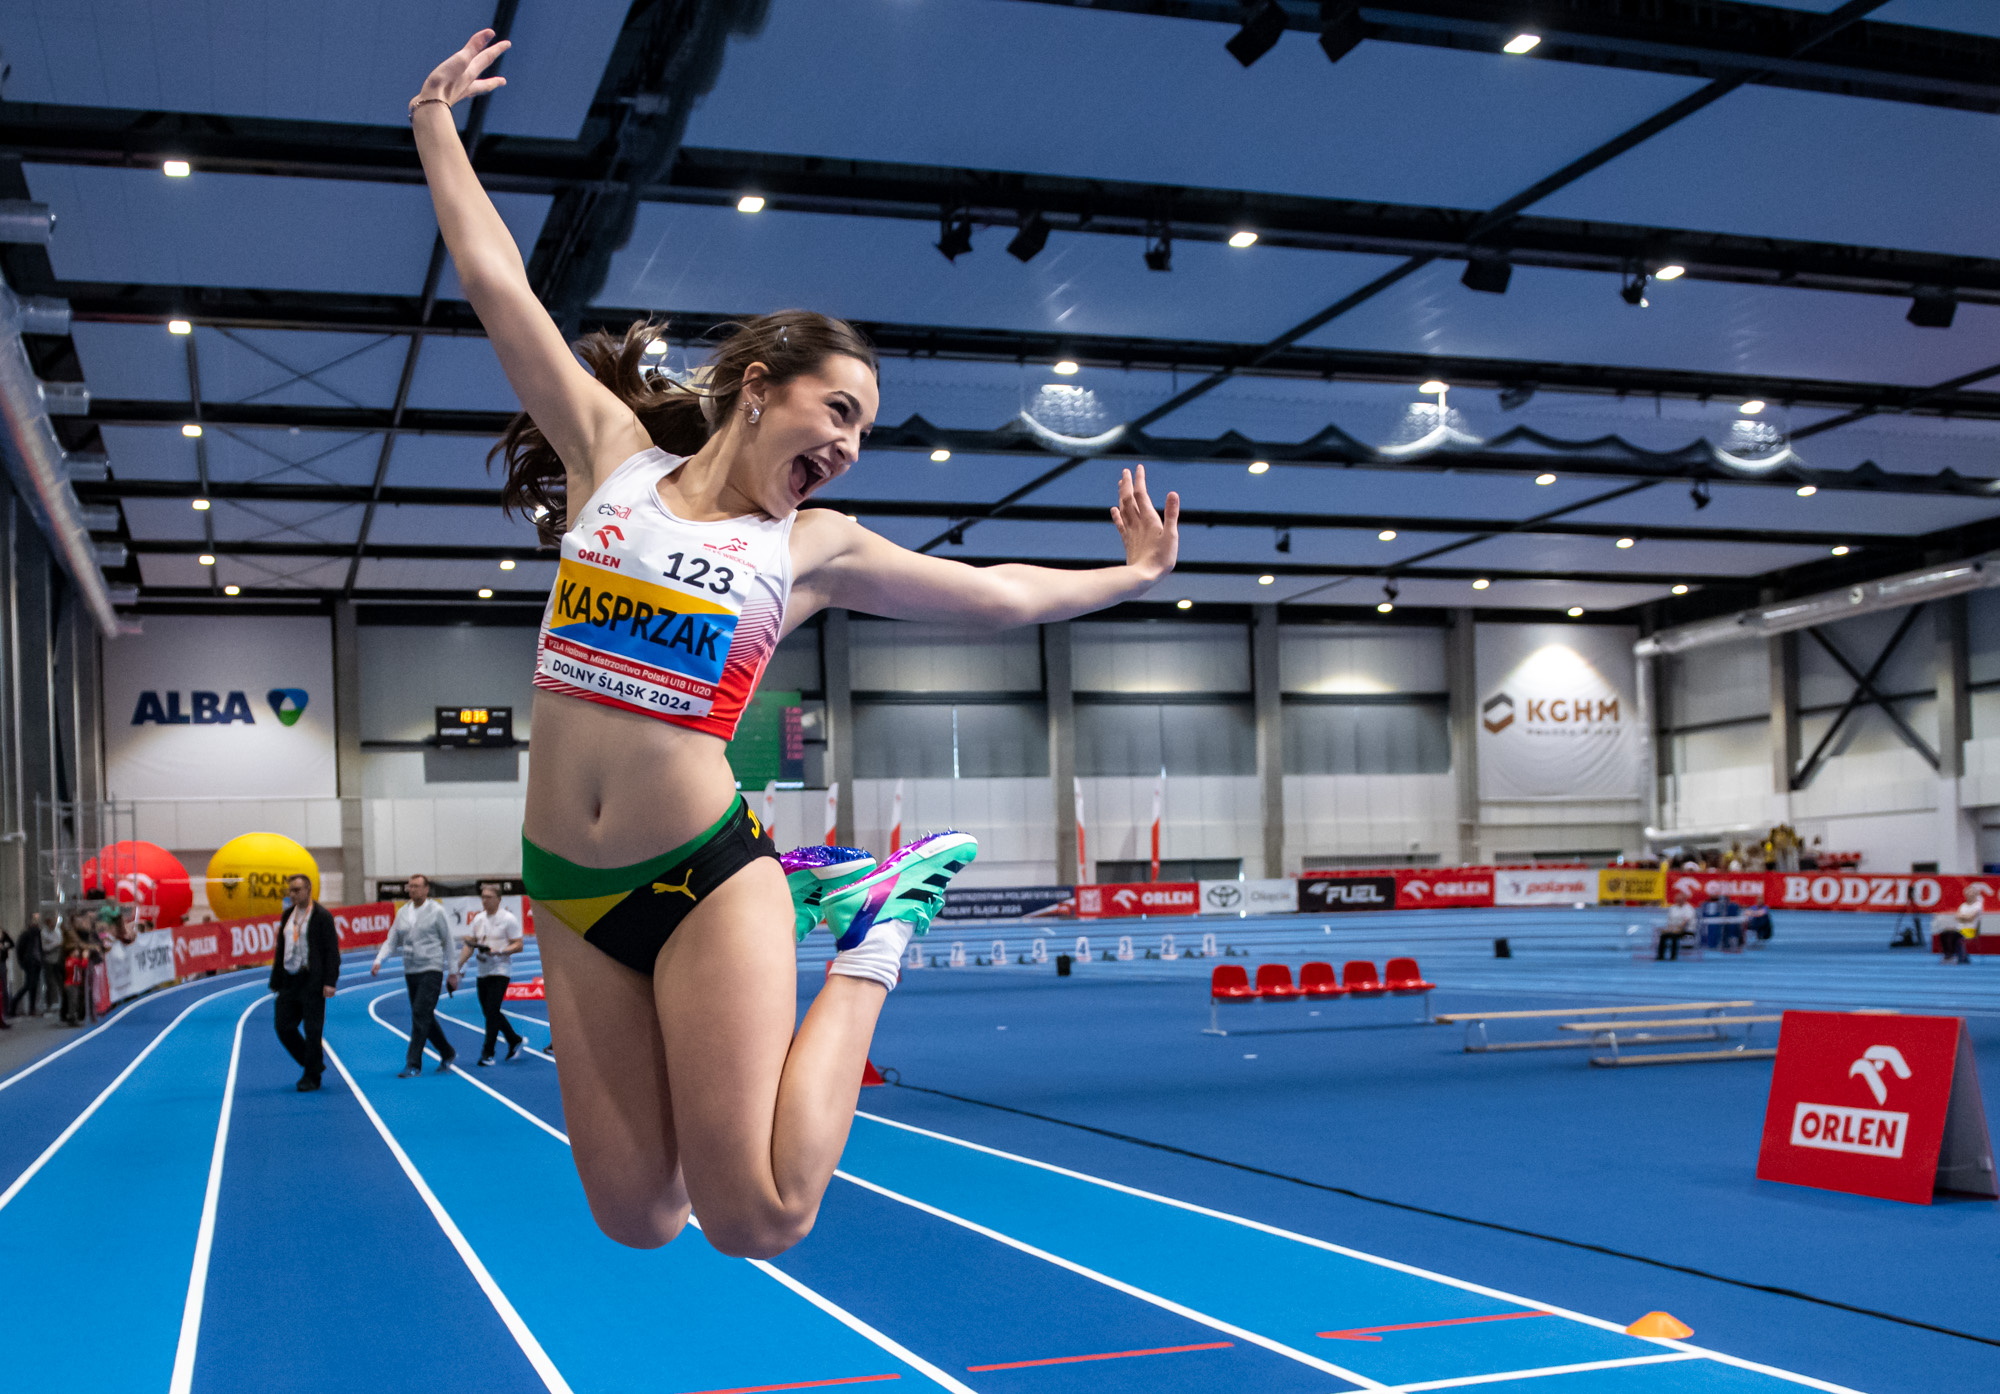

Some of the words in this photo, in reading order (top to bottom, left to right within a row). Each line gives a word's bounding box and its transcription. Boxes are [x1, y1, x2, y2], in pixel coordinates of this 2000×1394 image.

[577, 549, 621, 569] ORLEN
[662, 552, 734, 595] 123
[558, 579, 725, 662] KASPRZAK
[565, 644, 589, 660] Halowe
[590, 654, 641, 676] Mistrzostwa
[642, 669, 670, 685] Polski
[670, 678, 686, 689] U18
[692, 685, 712, 696] U20
[553, 659, 595, 683] DOLNY
[598, 672, 647, 699] ŚLĄSK
[648, 690, 691, 711] 2024
[130, 690, 256, 725] ALBA
[1528, 699, 1619, 722] KGHM
[1141, 891, 1194, 905] ORLEN
[1325, 884, 1386, 904] FUEL
[1433, 880, 1490, 897] ORLEN
[1704, 879, 1764, 896] ORLEN
[1783, 876, 1942, 907] BODZIO
[352, 915, 391, 934] ORLEN
[231, 920, 281, 957] BOD
[506, 986, 544, 998] PZLA
[1800, 1111, 1899, 1149] ORLEN
